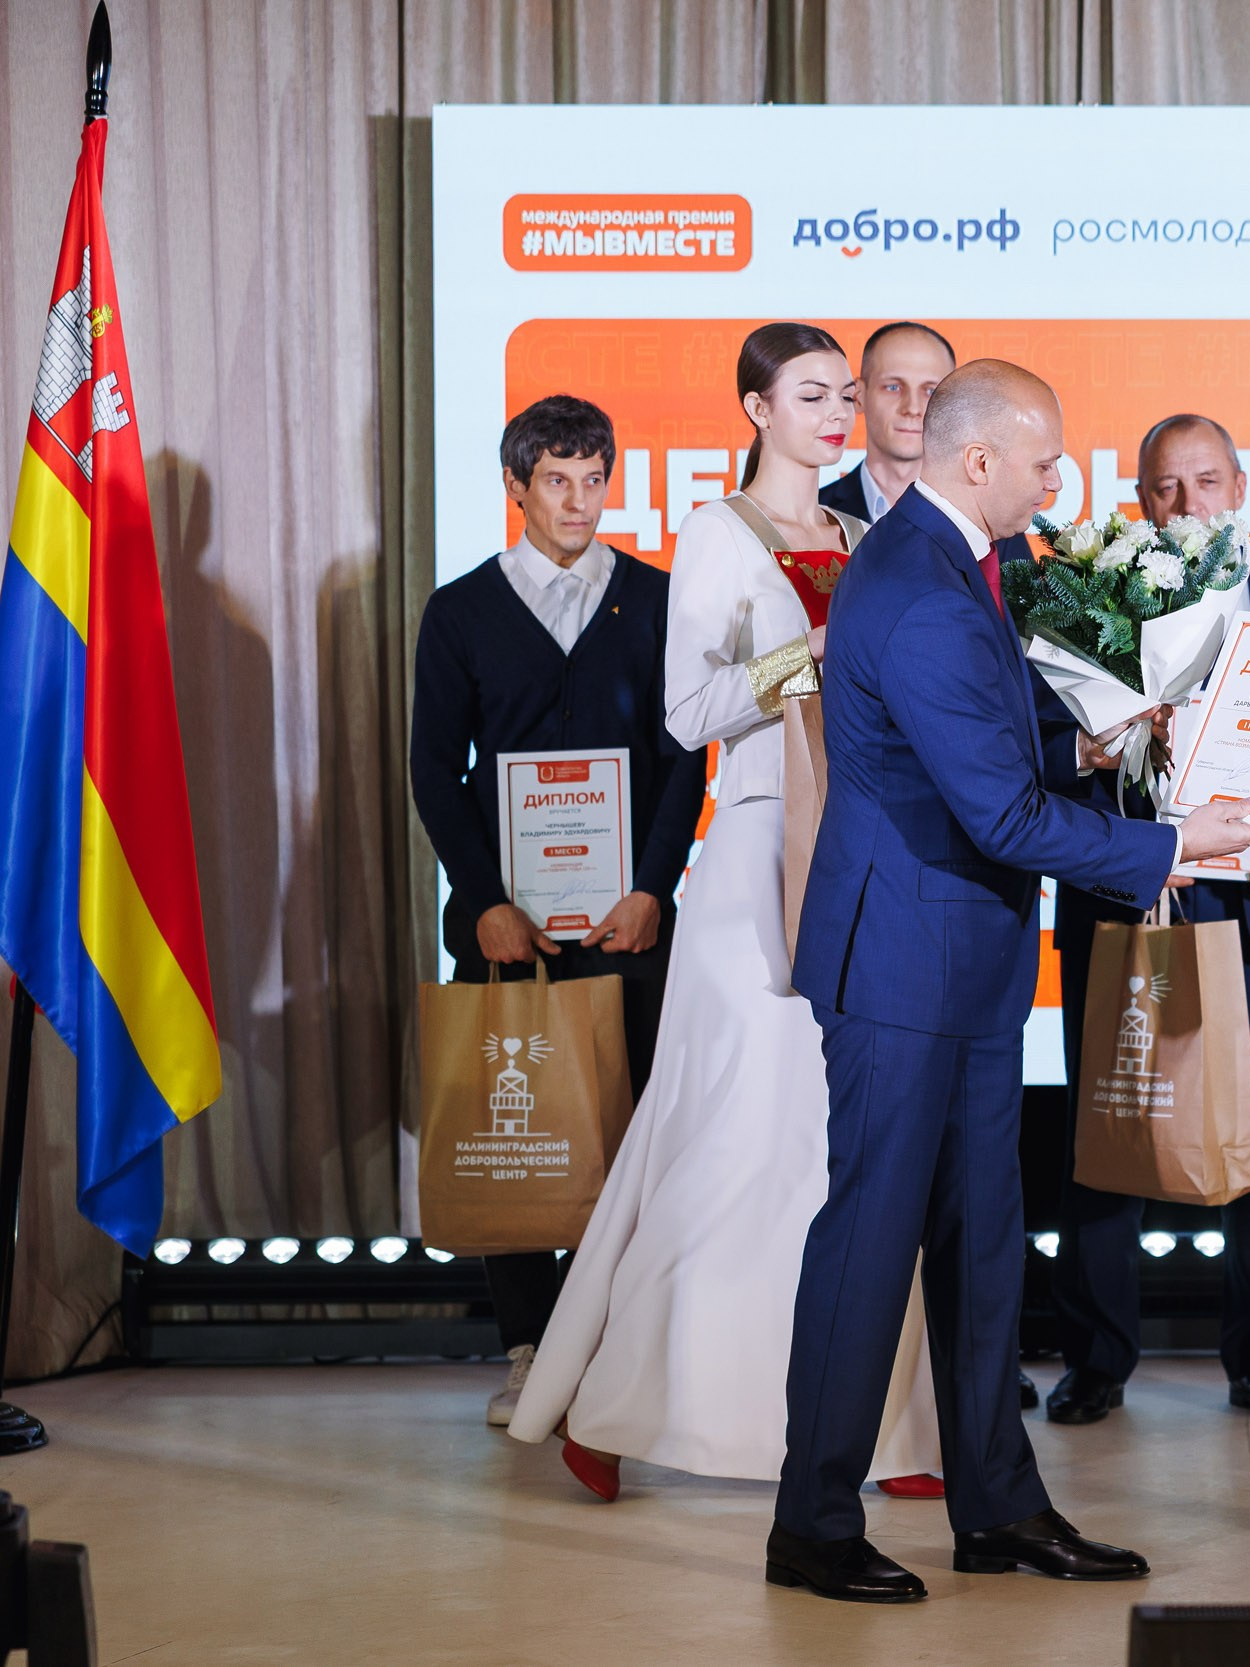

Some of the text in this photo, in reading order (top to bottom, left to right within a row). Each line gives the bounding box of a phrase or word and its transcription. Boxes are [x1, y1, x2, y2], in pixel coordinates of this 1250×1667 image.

[521, 209, 735, 228] международная премия
[793, 208, 1020, 251] добро.рф
[522, 230, 735, 256] #МЫВМЕСТЕ
[523, 791, 605, 810] ДИПЛОМ
[554, 847, 582, 855] МЕСТО
[456, 1139, 570, 1152] КАЛИНИНГРАДСКИЙ
[454, 1153, 570, 1166] ДОБРОВОЛЬЧЕСКИЙ
[491, 1169, 528, 1180] ЦЕНТР
